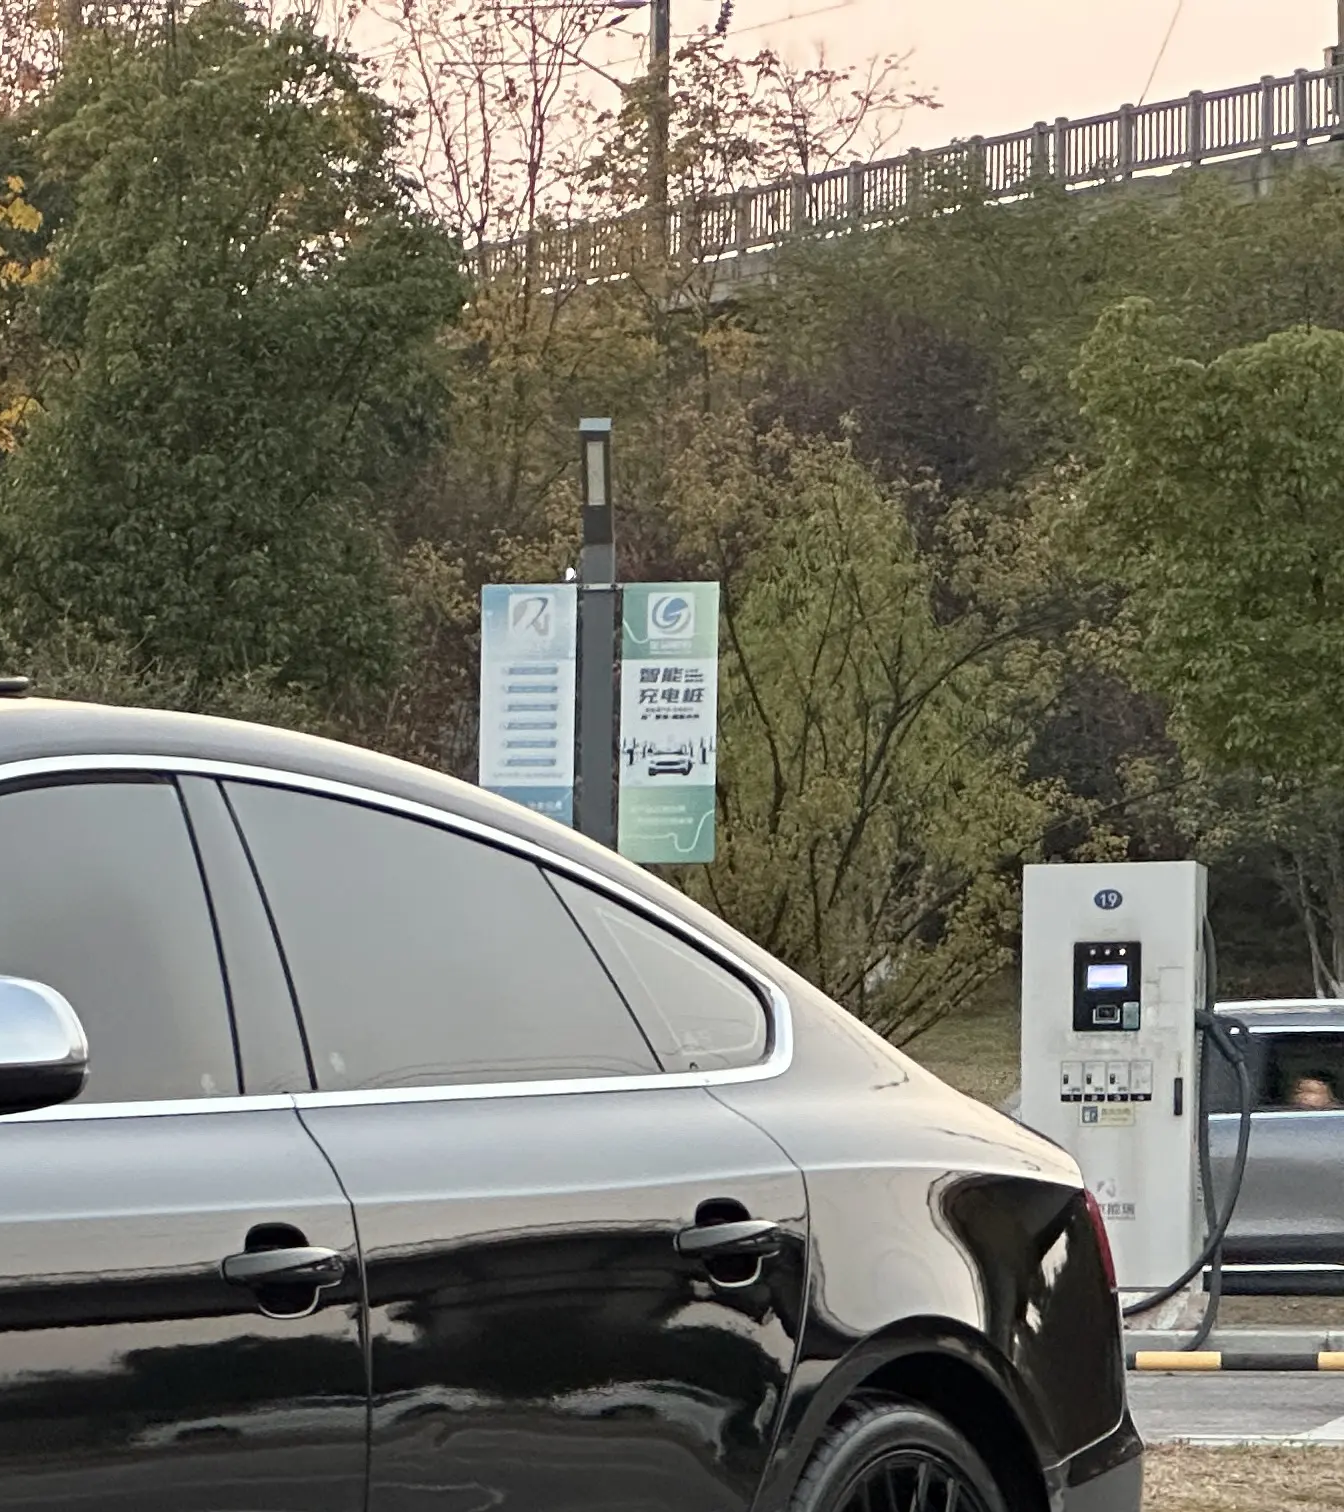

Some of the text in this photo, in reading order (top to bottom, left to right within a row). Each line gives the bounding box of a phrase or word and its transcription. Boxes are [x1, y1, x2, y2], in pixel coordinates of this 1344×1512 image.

[639, 667, 684, 683] 智能
[639, 687, 705, 704] 充电桩
[1099, 892, 1118, 908] 19
